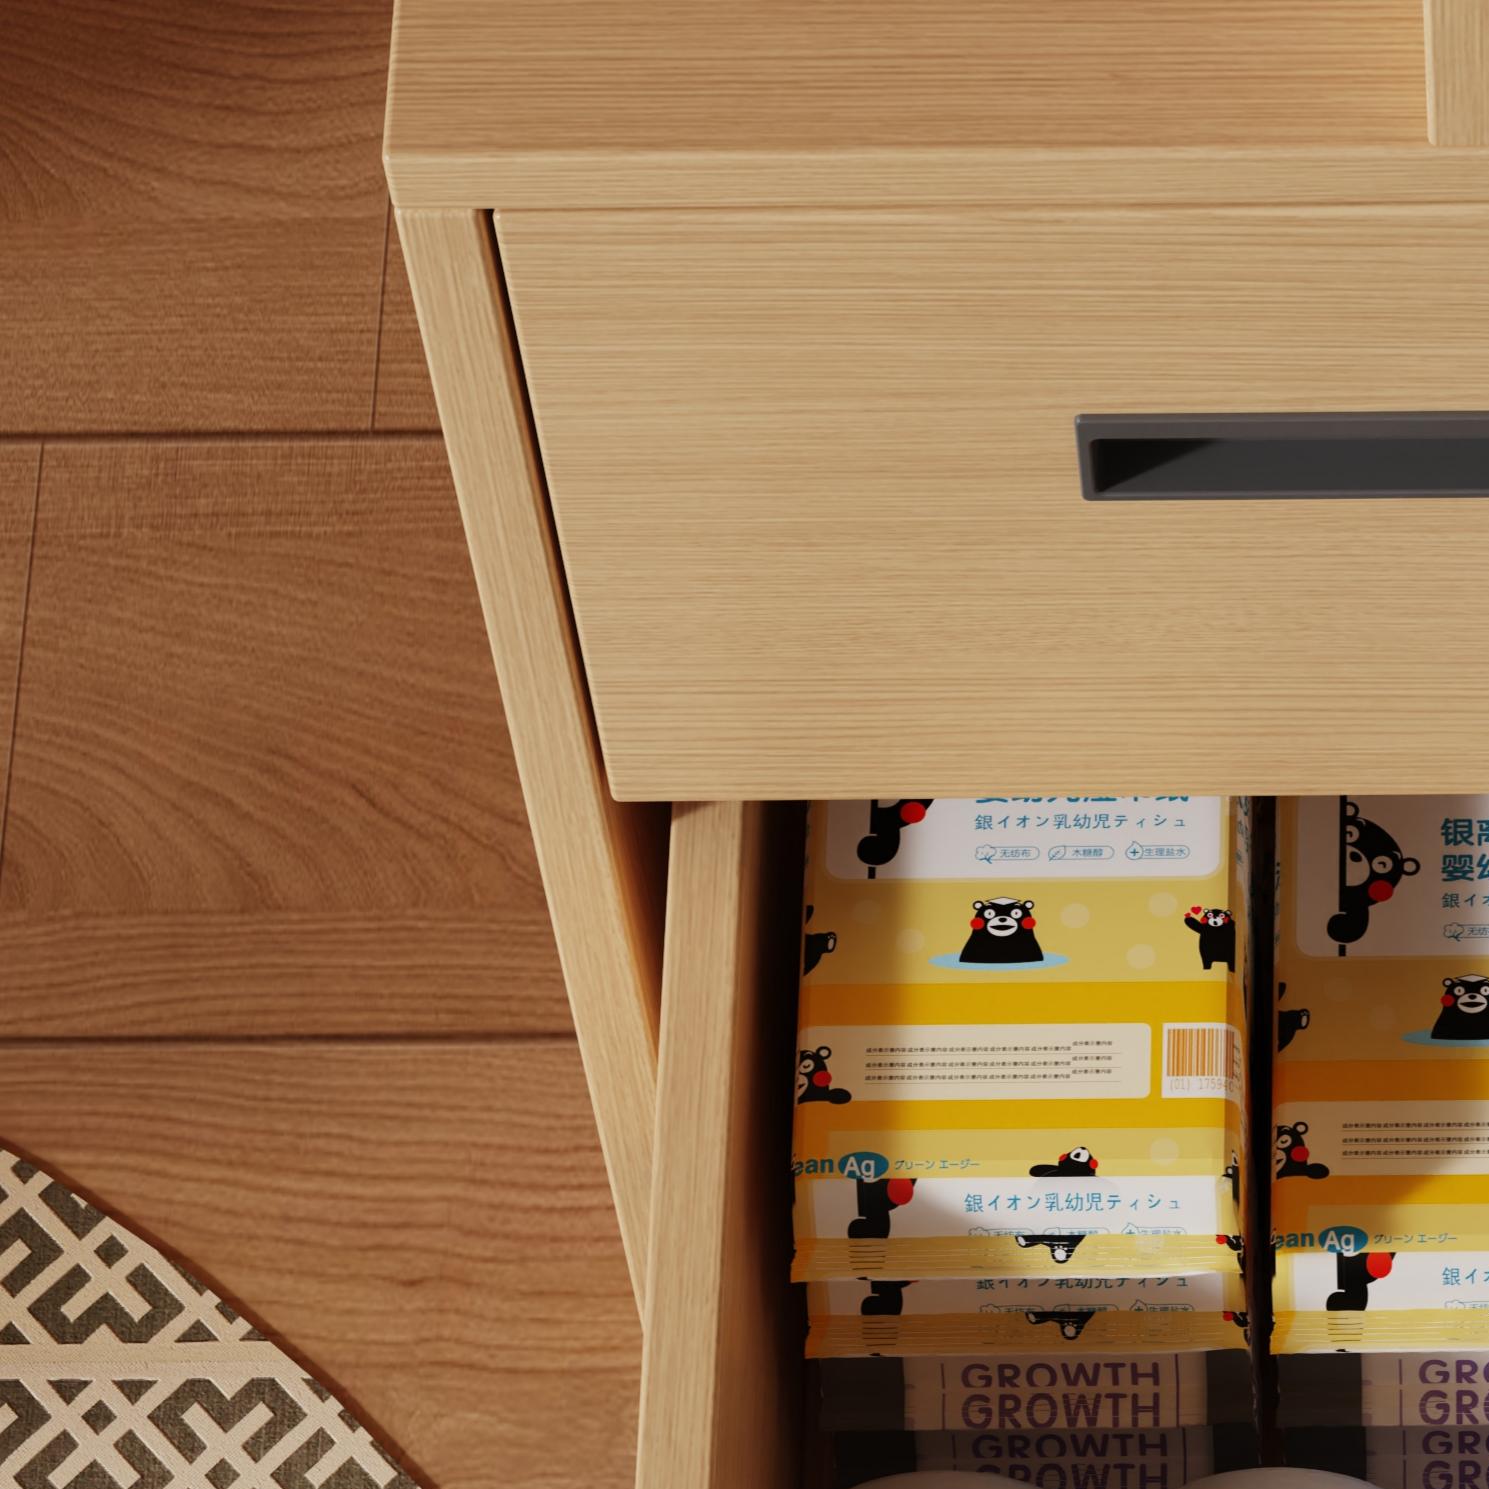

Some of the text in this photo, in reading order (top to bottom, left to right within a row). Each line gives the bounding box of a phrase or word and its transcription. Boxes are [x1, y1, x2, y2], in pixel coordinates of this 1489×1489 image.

[844, 1156, 875, 1180] Ag
[964, 1193, 1181, 1213] 銀イオン乳幼児ティシュ
[1324, 1230, 1355, 1256] Ag
[961, 1362, 1160, 1388] GROWTH
[961, 1392, 1160, 1429] GROWTH
[972, 1434, 1168, 1459] GROWTH
